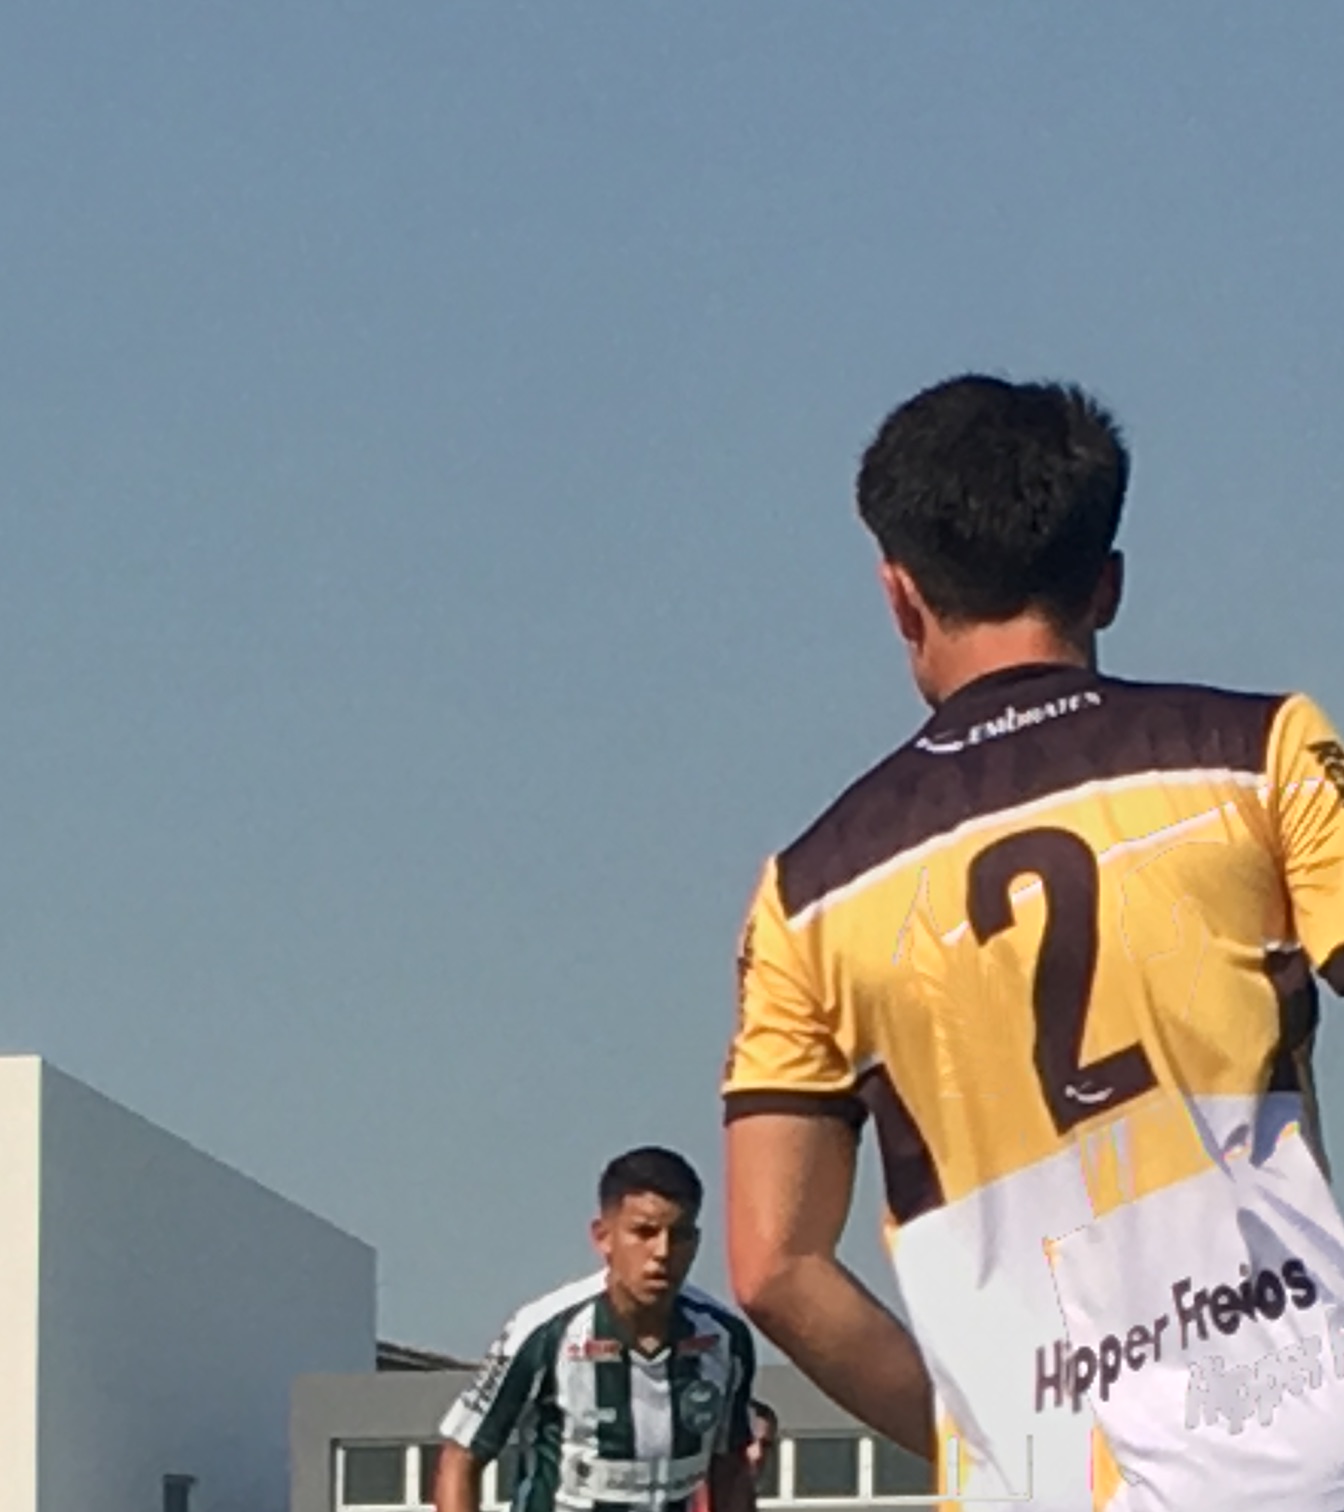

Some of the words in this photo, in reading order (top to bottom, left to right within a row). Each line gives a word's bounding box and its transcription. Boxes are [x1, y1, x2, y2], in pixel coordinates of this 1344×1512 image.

[966, 826, 1159, 1137] 2
[1035, 1313, 1169, 1413] Hipper
[1171, 1257, 1318, 1350] Freios
